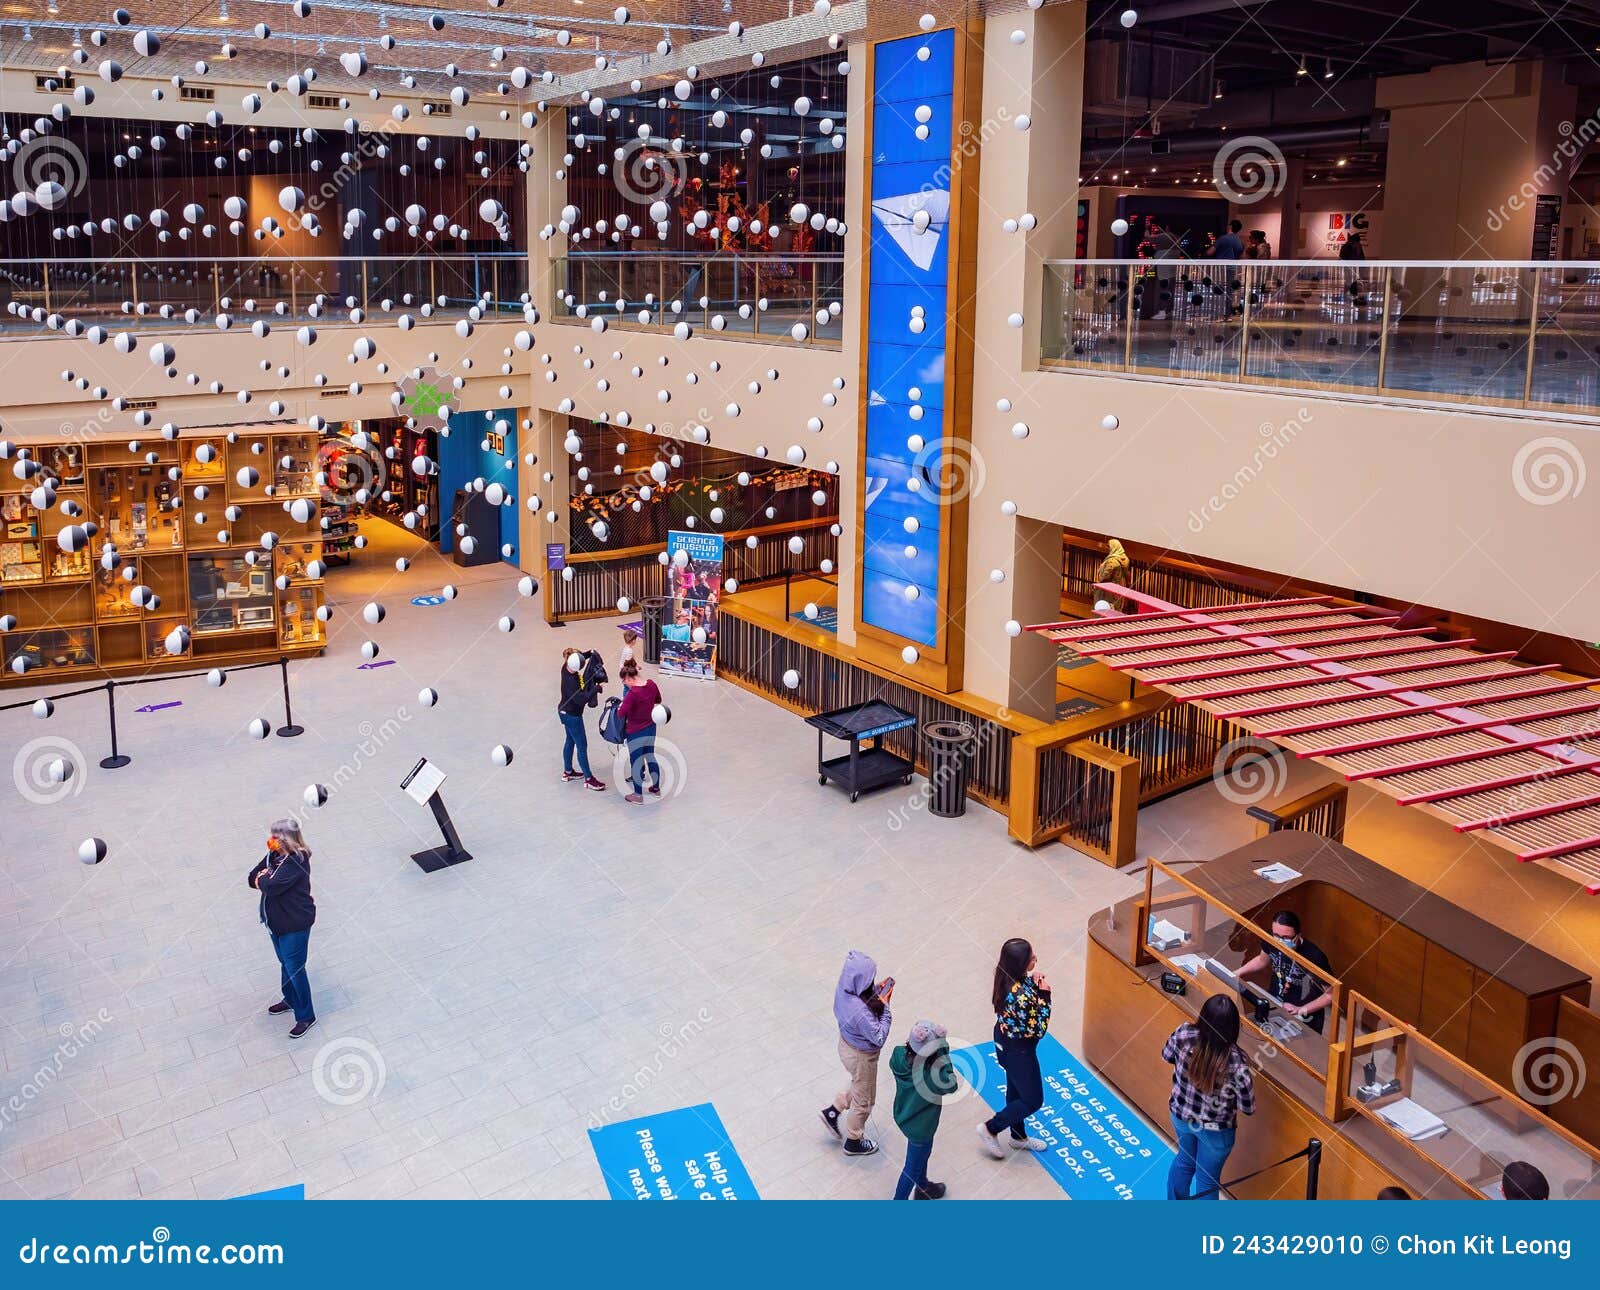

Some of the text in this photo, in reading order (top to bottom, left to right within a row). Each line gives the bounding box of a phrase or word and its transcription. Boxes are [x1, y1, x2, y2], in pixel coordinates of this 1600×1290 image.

[1329, 213, 1369, 230] BIG
[672, 541, 719, 553] museum
[1044, 1075, 1135, 1160] safe distance!
[1058, 1068, 1152, 1158] Help us keep a
[636, 1128, 663, 1174] Please
[1051, 1117, 1083, 1147] here
[1081, 1149, 1102, 1164] or
[1097, 1166, 1116, 1182] in
[1055, 1146, 1086, 1178] box.
[628, 1168, 652, 1200] next
[684, 1159, 707, 1189] safe
[703, 1151, 728, 1185] Help
